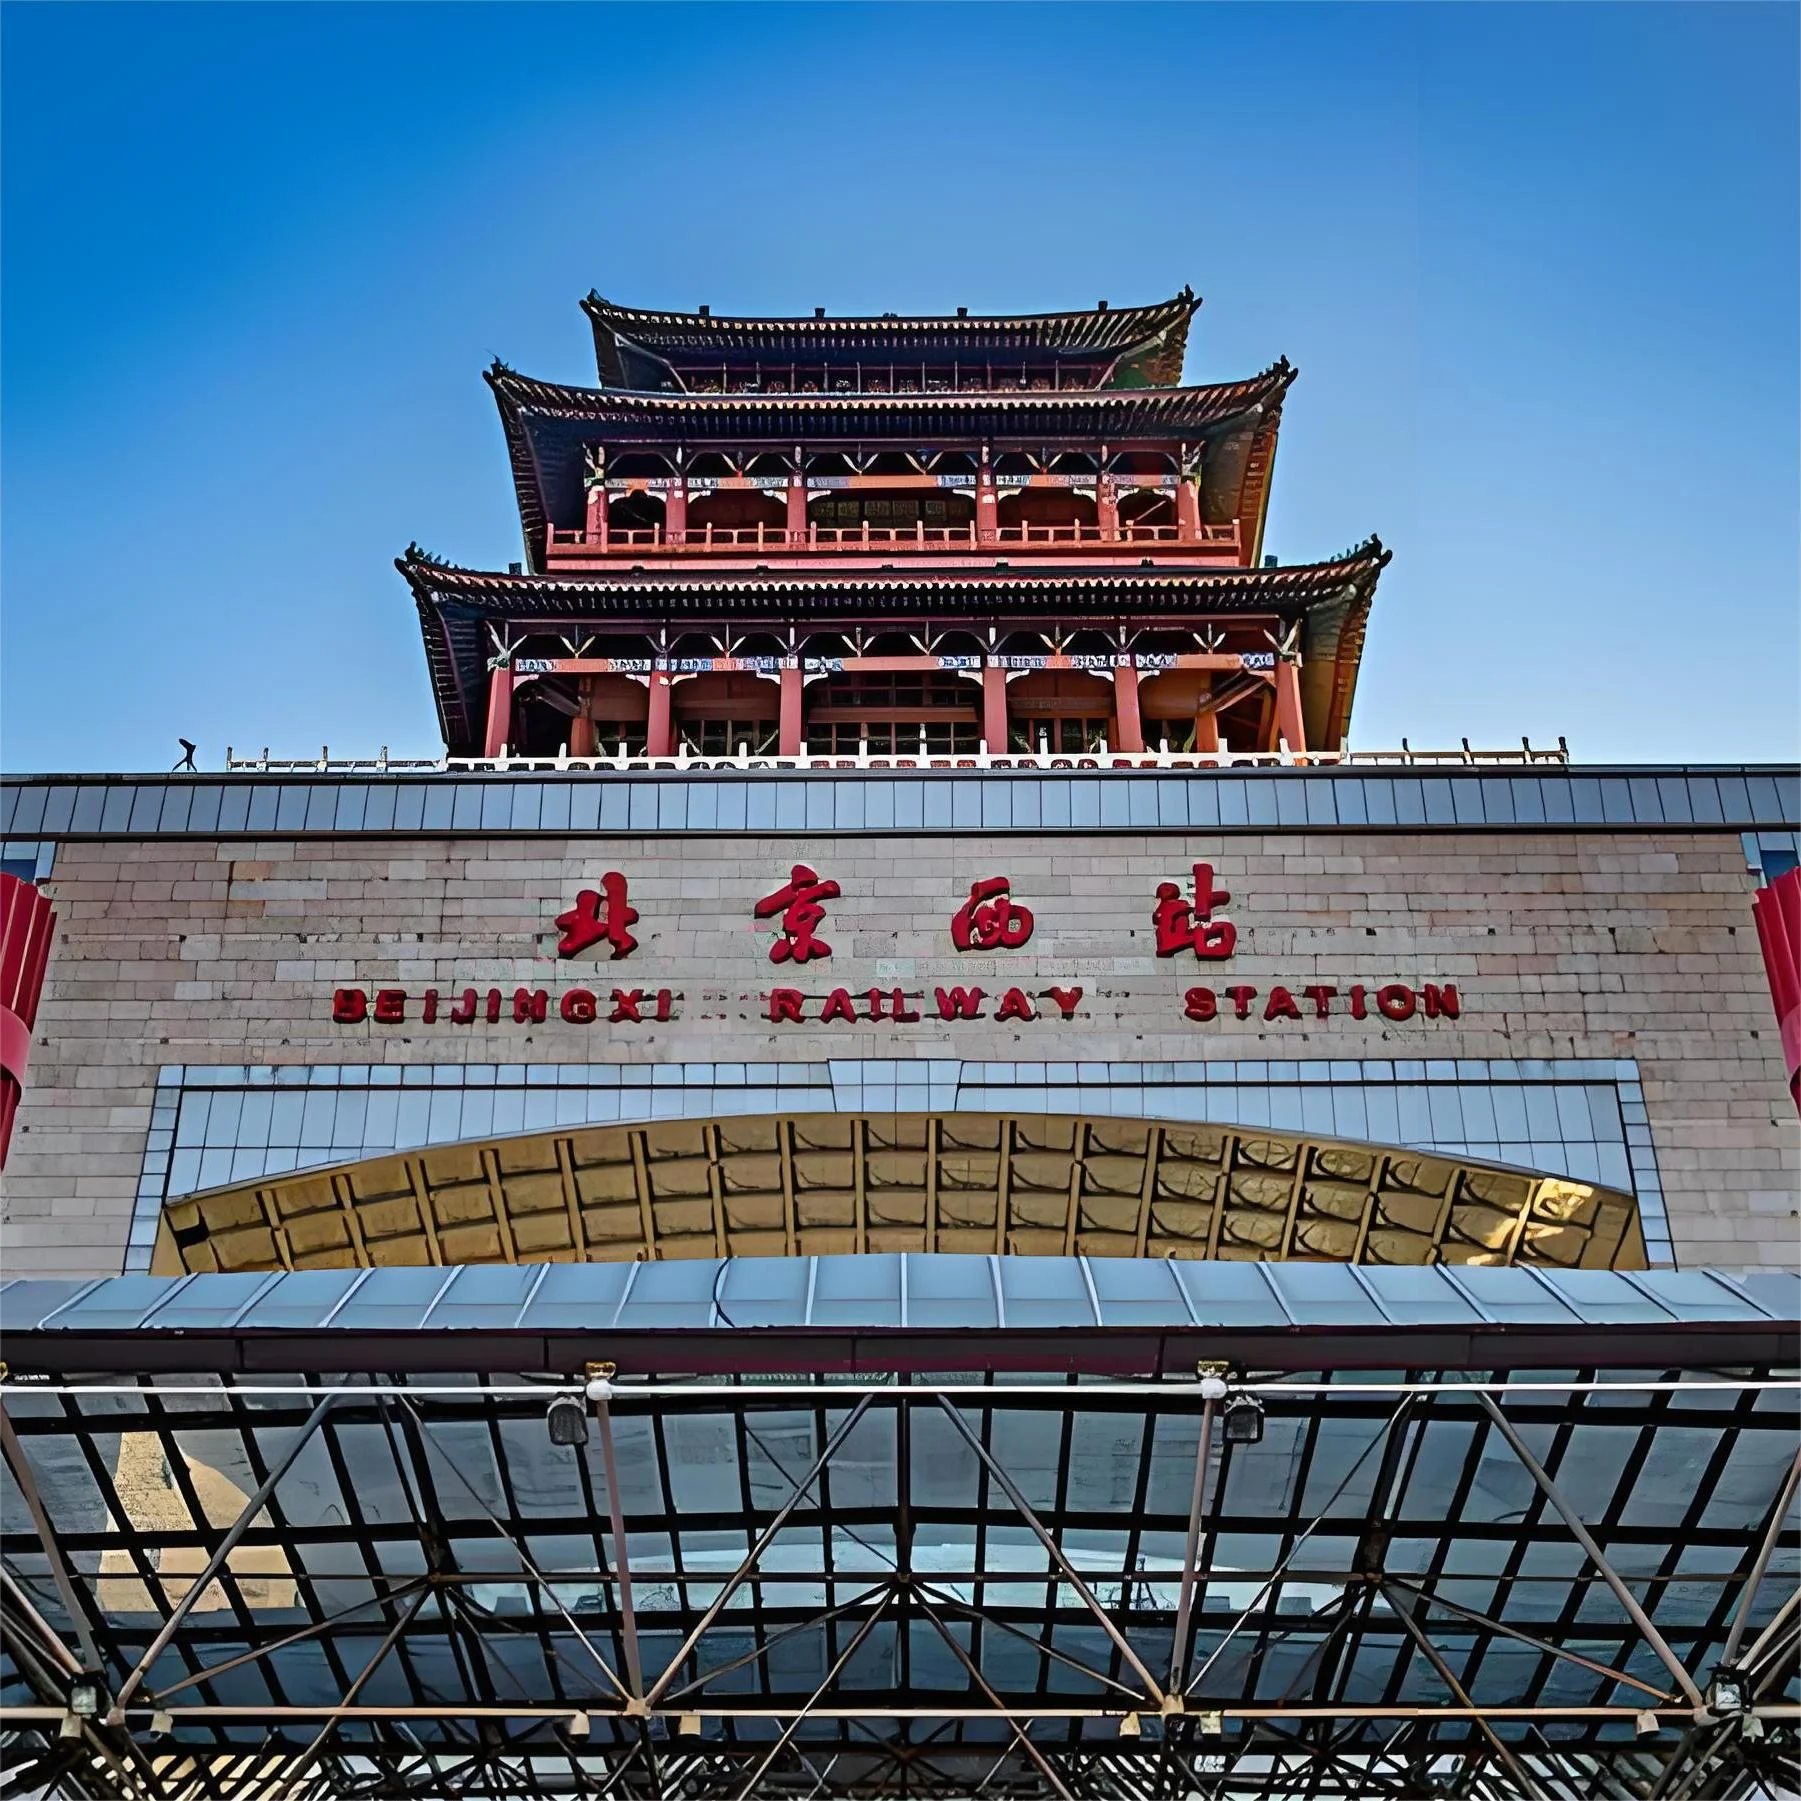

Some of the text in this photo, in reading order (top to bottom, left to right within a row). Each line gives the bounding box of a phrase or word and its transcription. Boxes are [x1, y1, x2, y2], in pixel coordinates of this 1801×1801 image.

[555, 863, 1238, 963] 北京西站
[332, 983, 1461, 1025] BEIJINGXI RAILWAY STATION
